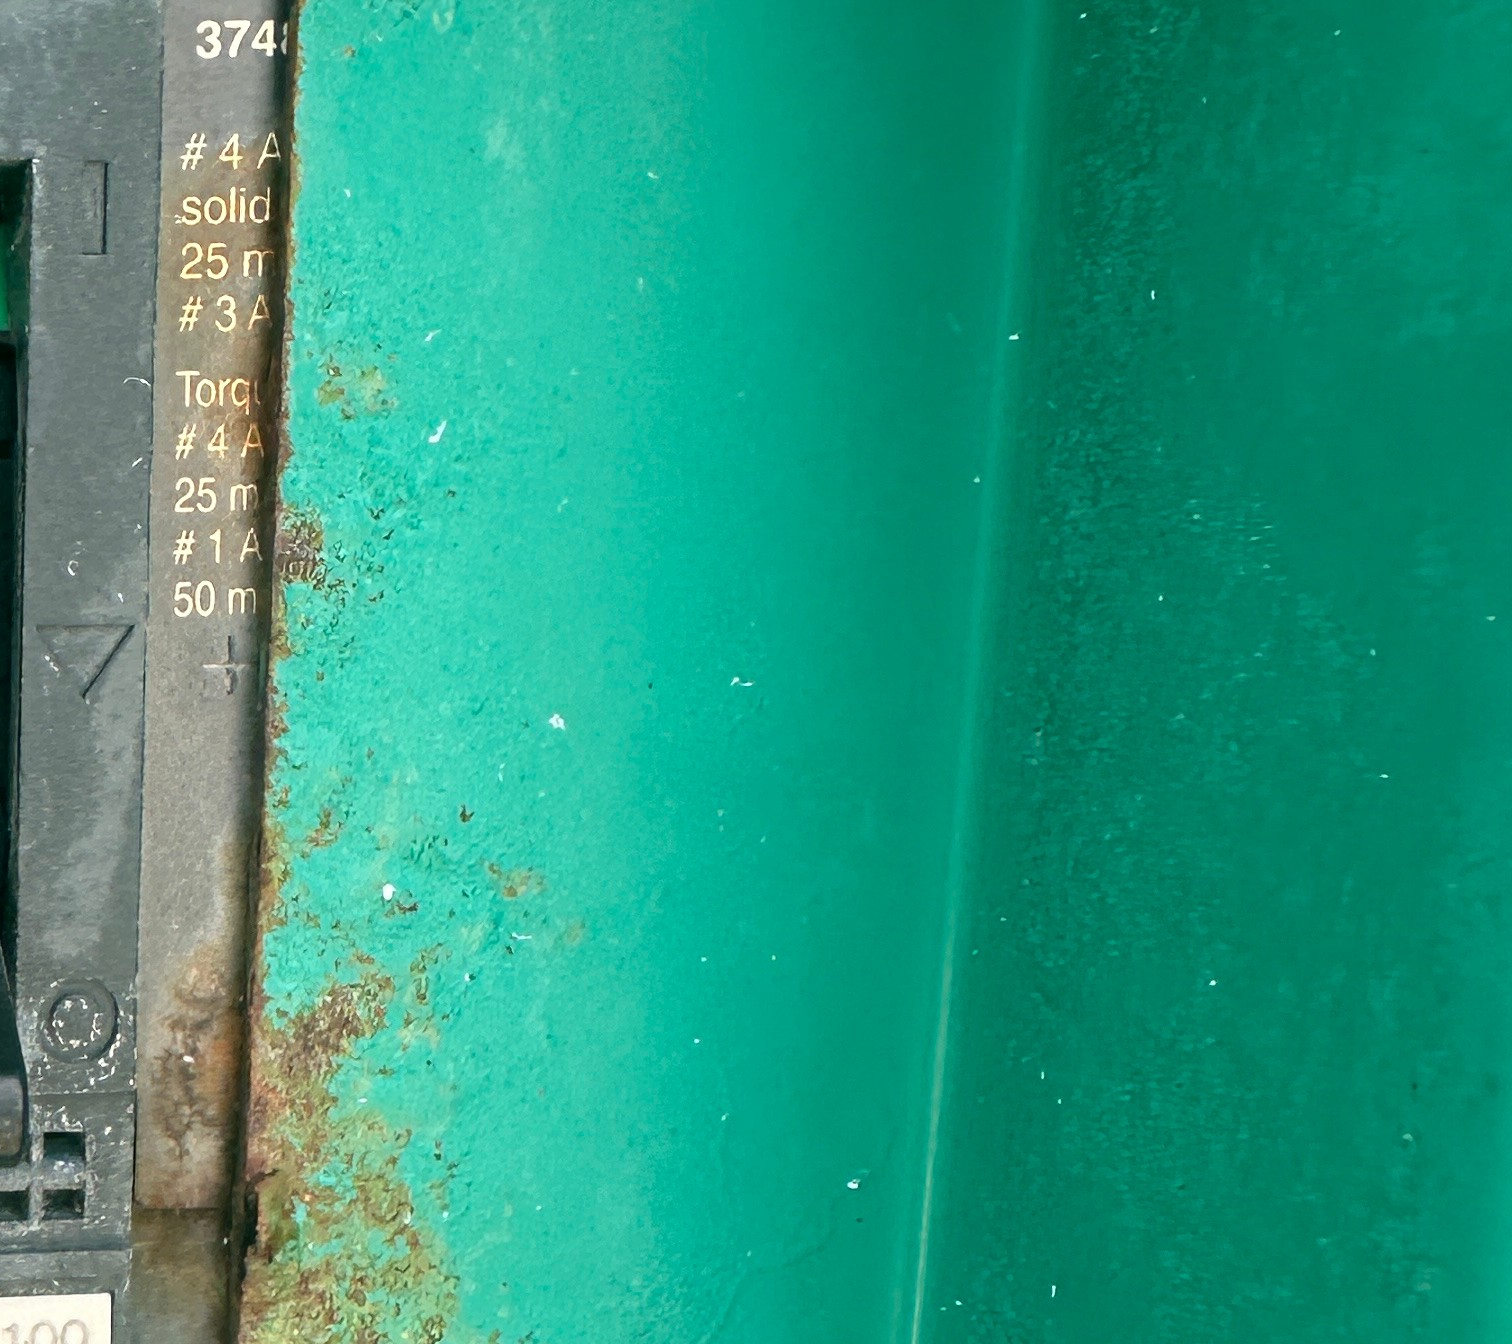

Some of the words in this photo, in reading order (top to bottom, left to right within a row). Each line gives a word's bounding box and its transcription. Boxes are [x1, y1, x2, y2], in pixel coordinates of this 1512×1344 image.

[219, 132, 243, 170] 4
[180, 186, 271, 225] solid
[180, 242, 229, 279] 25
[214, 294, 237, 333] 3
[207, 423, 230, 459] 4
[174, 476, 218, 513] 25
[208, 528, 222, 564] 1
[173, 580, 217, 617] 50
